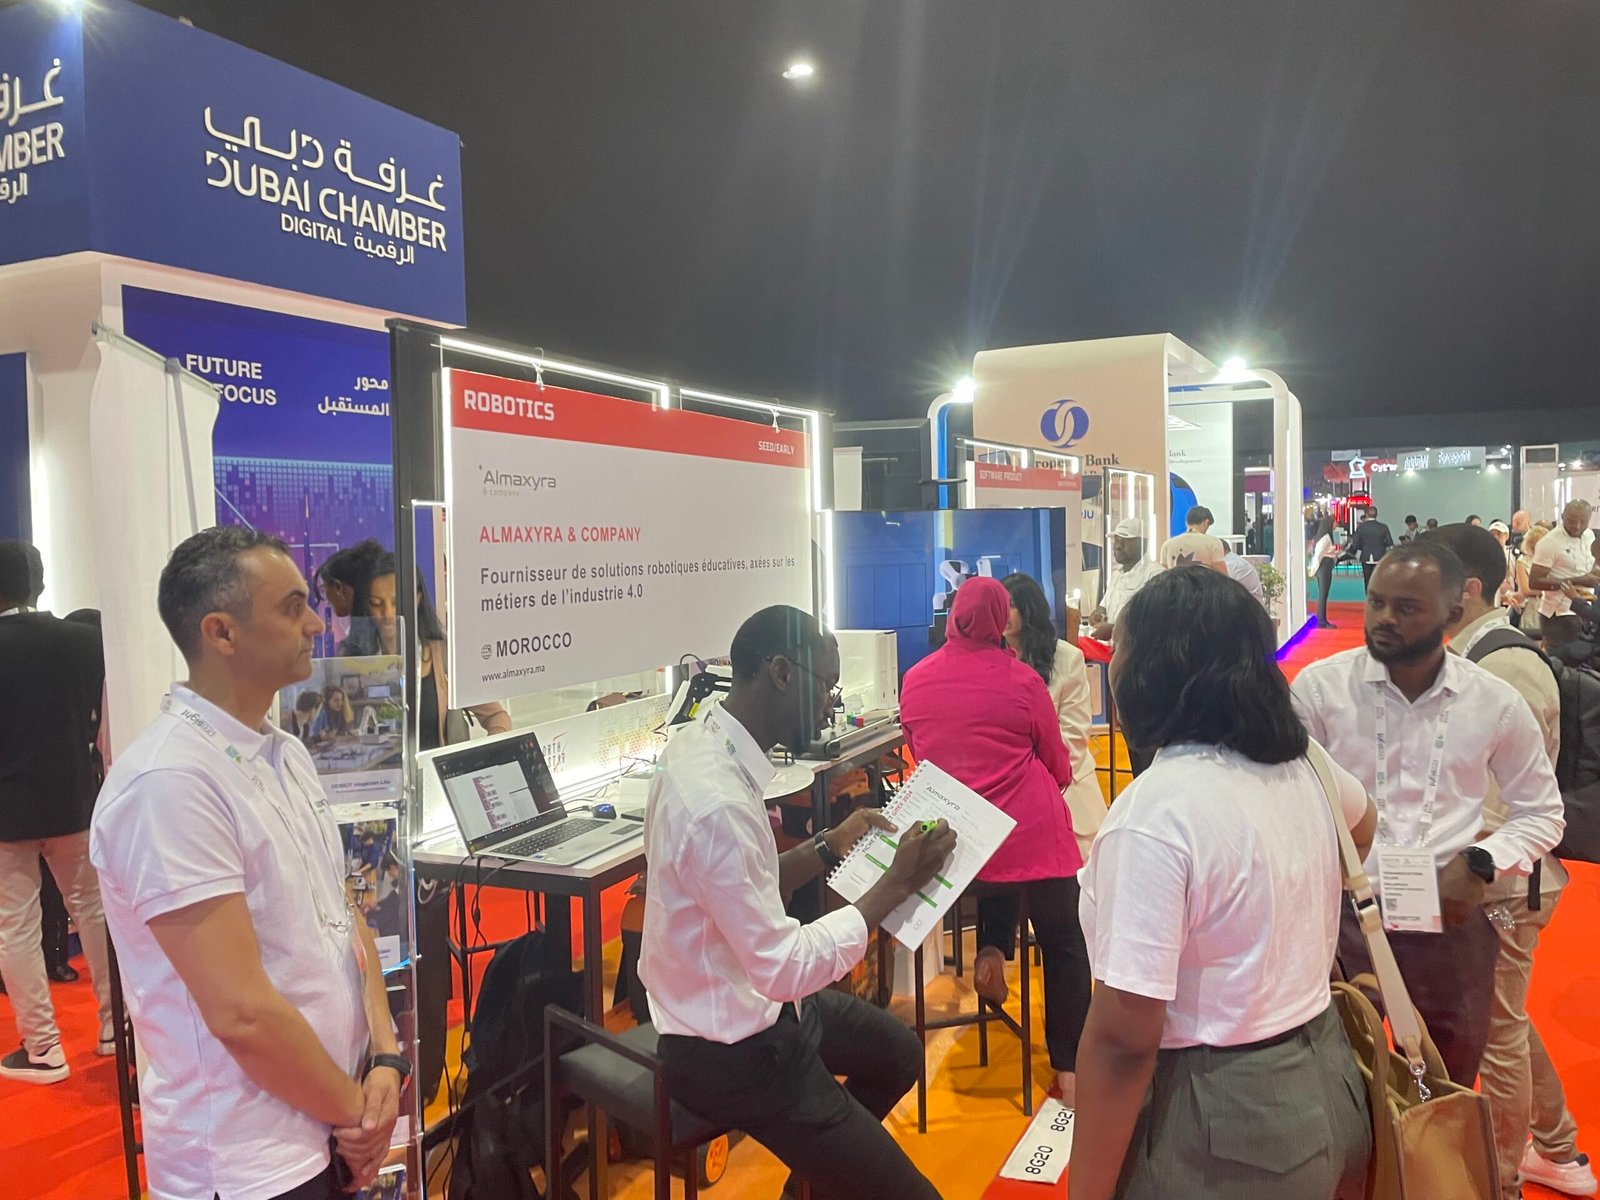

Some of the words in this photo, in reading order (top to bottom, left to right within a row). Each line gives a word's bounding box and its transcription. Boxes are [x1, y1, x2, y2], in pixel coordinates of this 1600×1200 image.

[204, 107, 324, 171] دبي
[334, 139, 446, 211] غرفة
[206, 150, 310, 212] DUBAI
[319, 188, 447, 252] CHAMBER
[281, 213, 347, 247] DIGITAL
[354, 232, 414, 265] الرقمية
[186, 354, 263, 379] FUTURE
[354, 376, 389, 391] محور
[317, 396, 390, 416] المستقبل
[464, 389, 555, 421] ROBOTICS
[758, 441, 795, 455] SEED/EARLY
[1085, 453, 1120, 466] Bank
[483, 469, 557, 491] Almaxyra
[979, 470, 1003, 480] SOFTWARE
[1003, 471, 1022, 481] PRODUCT
[479, 525, 563, 543] ALMAXYRA
[567, 525, 577, 542] &
[581, 526, 641, 542] COMPANY
[480, 566, 567, 584] Fournisseur
[571, 563, 587, 579] de
[591, 562, 644, 578] solutions
[647, 560, 699, 576] robotiques
[702, 557, 748, 572] éducatives,
[750, 556, 771, 569] axées
[772, 557, 783, 568] sur
[785, 555, 795, 567] les
[481, 593, 536, 612] métiers
[541, 590, 557, 606] de
[562, 585, 624, 604] l'industrie
[627, 583, 643, 598] 4.0
[496, 632, 572, 658] MOROCCO
[482, 665, 546, 682] www.almaxyra.ma
[926, 785, 961, 811] Almaxyra
[1025, 1145, 1053, 1175] 8G20
